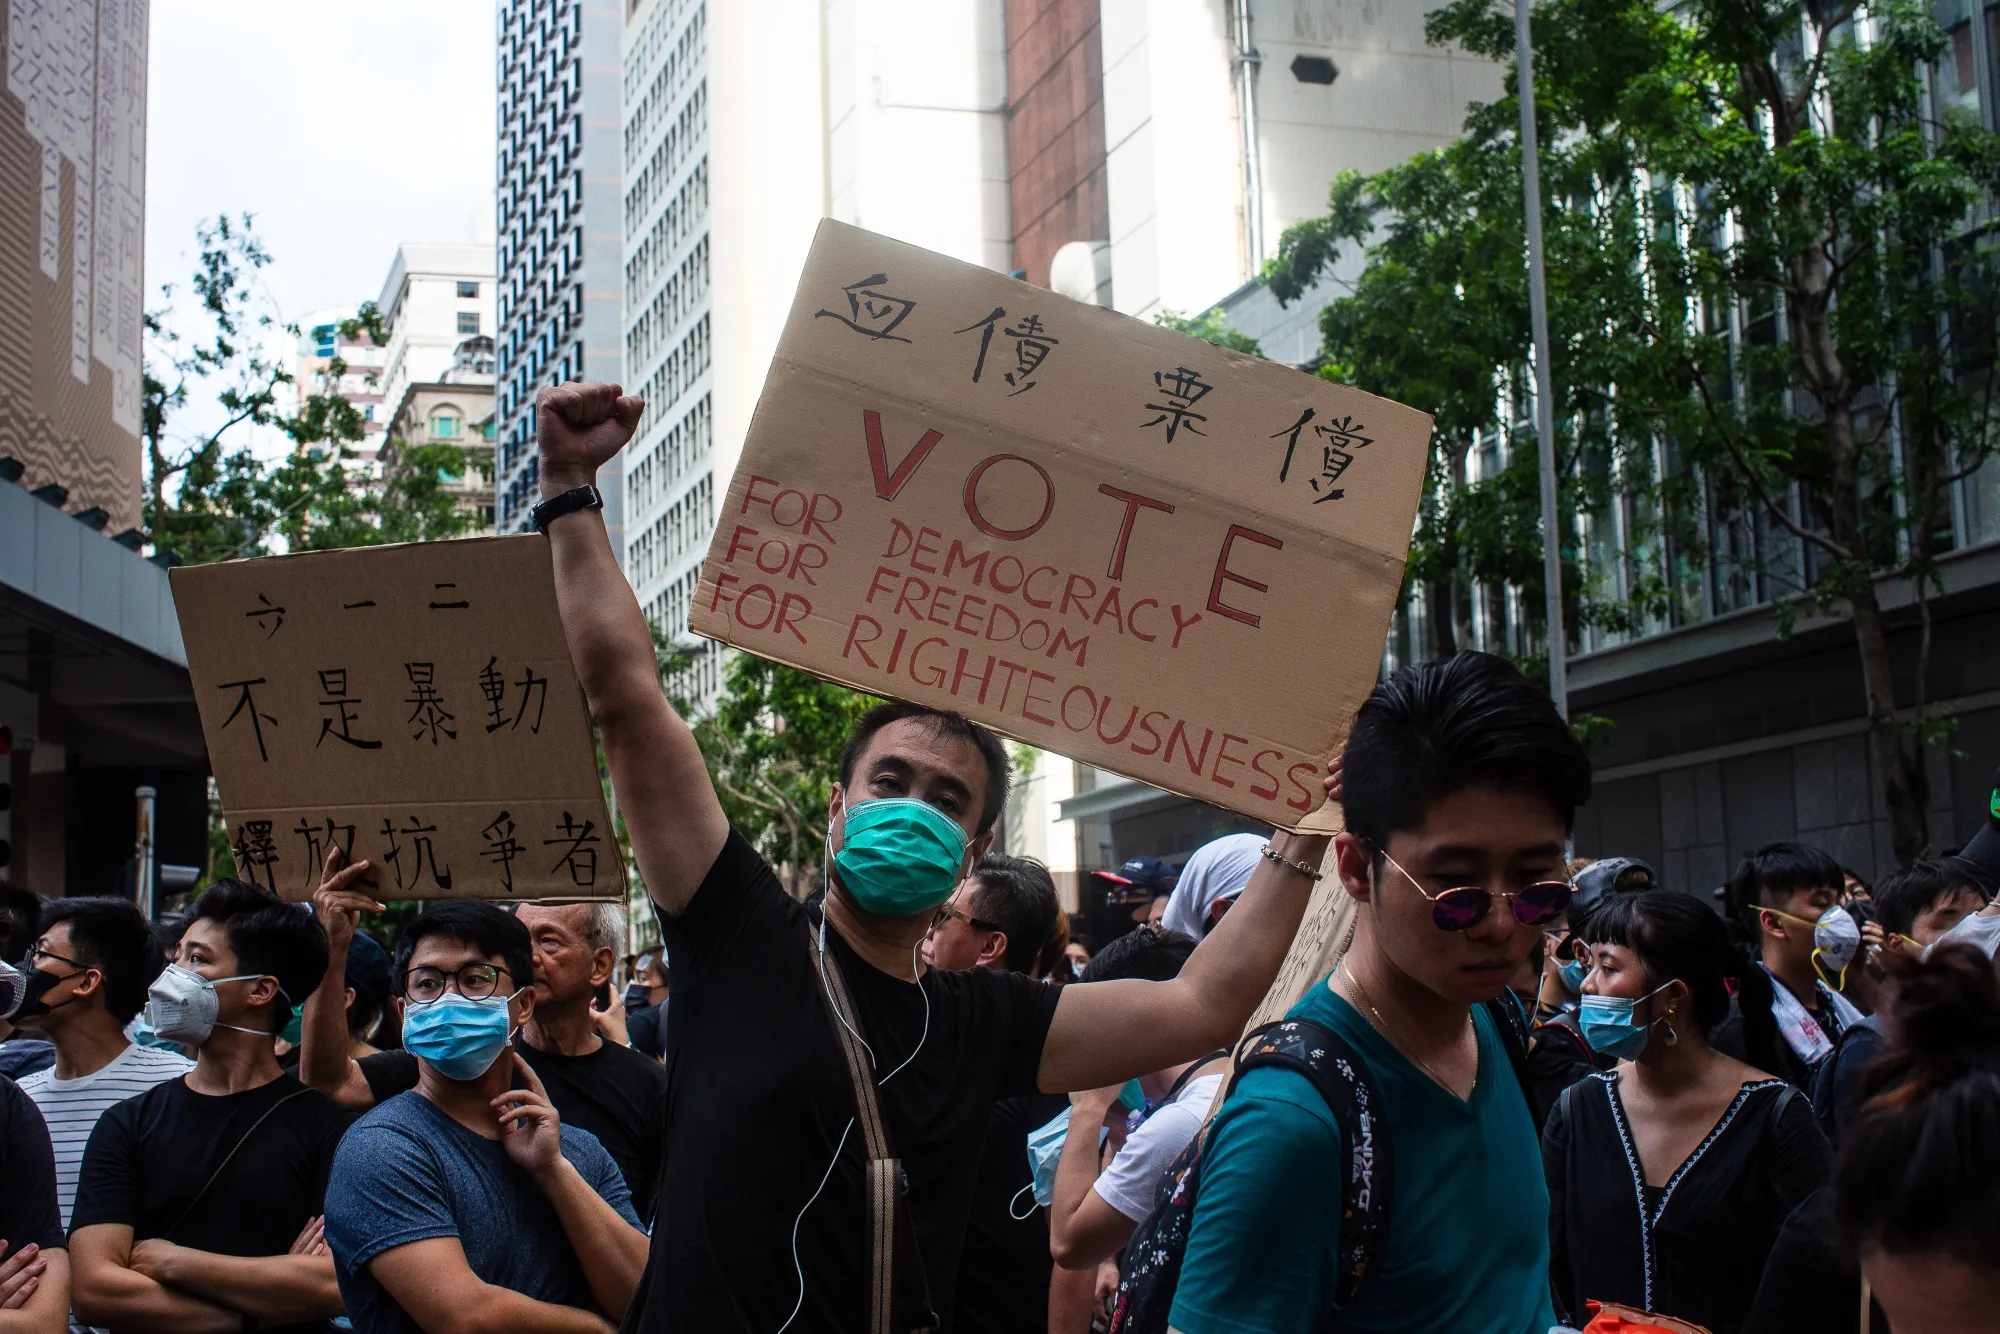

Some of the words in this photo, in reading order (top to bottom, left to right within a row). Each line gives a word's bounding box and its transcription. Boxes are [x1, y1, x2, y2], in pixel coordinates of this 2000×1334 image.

[740, 475, 844, 545] FOR
[882, 519, 1203, 649] DEMOCRACY
[863, 410, 1283, 629] VOTE
[246, 583, 470, 639] 六一二
[725, 525, 828, 586] FOR
[866, 569, 1089, 667] FREEDOM
[216, 656, 548, 762] 不是暴動
[709, 571, 812, 646] FOR
[842, 614, 1320, 812] RIGHTEOUSNESS
[232, 810, 601, 894] 釋放抗爭者
[1358, 1111, 1373, 1212] DAKINE
